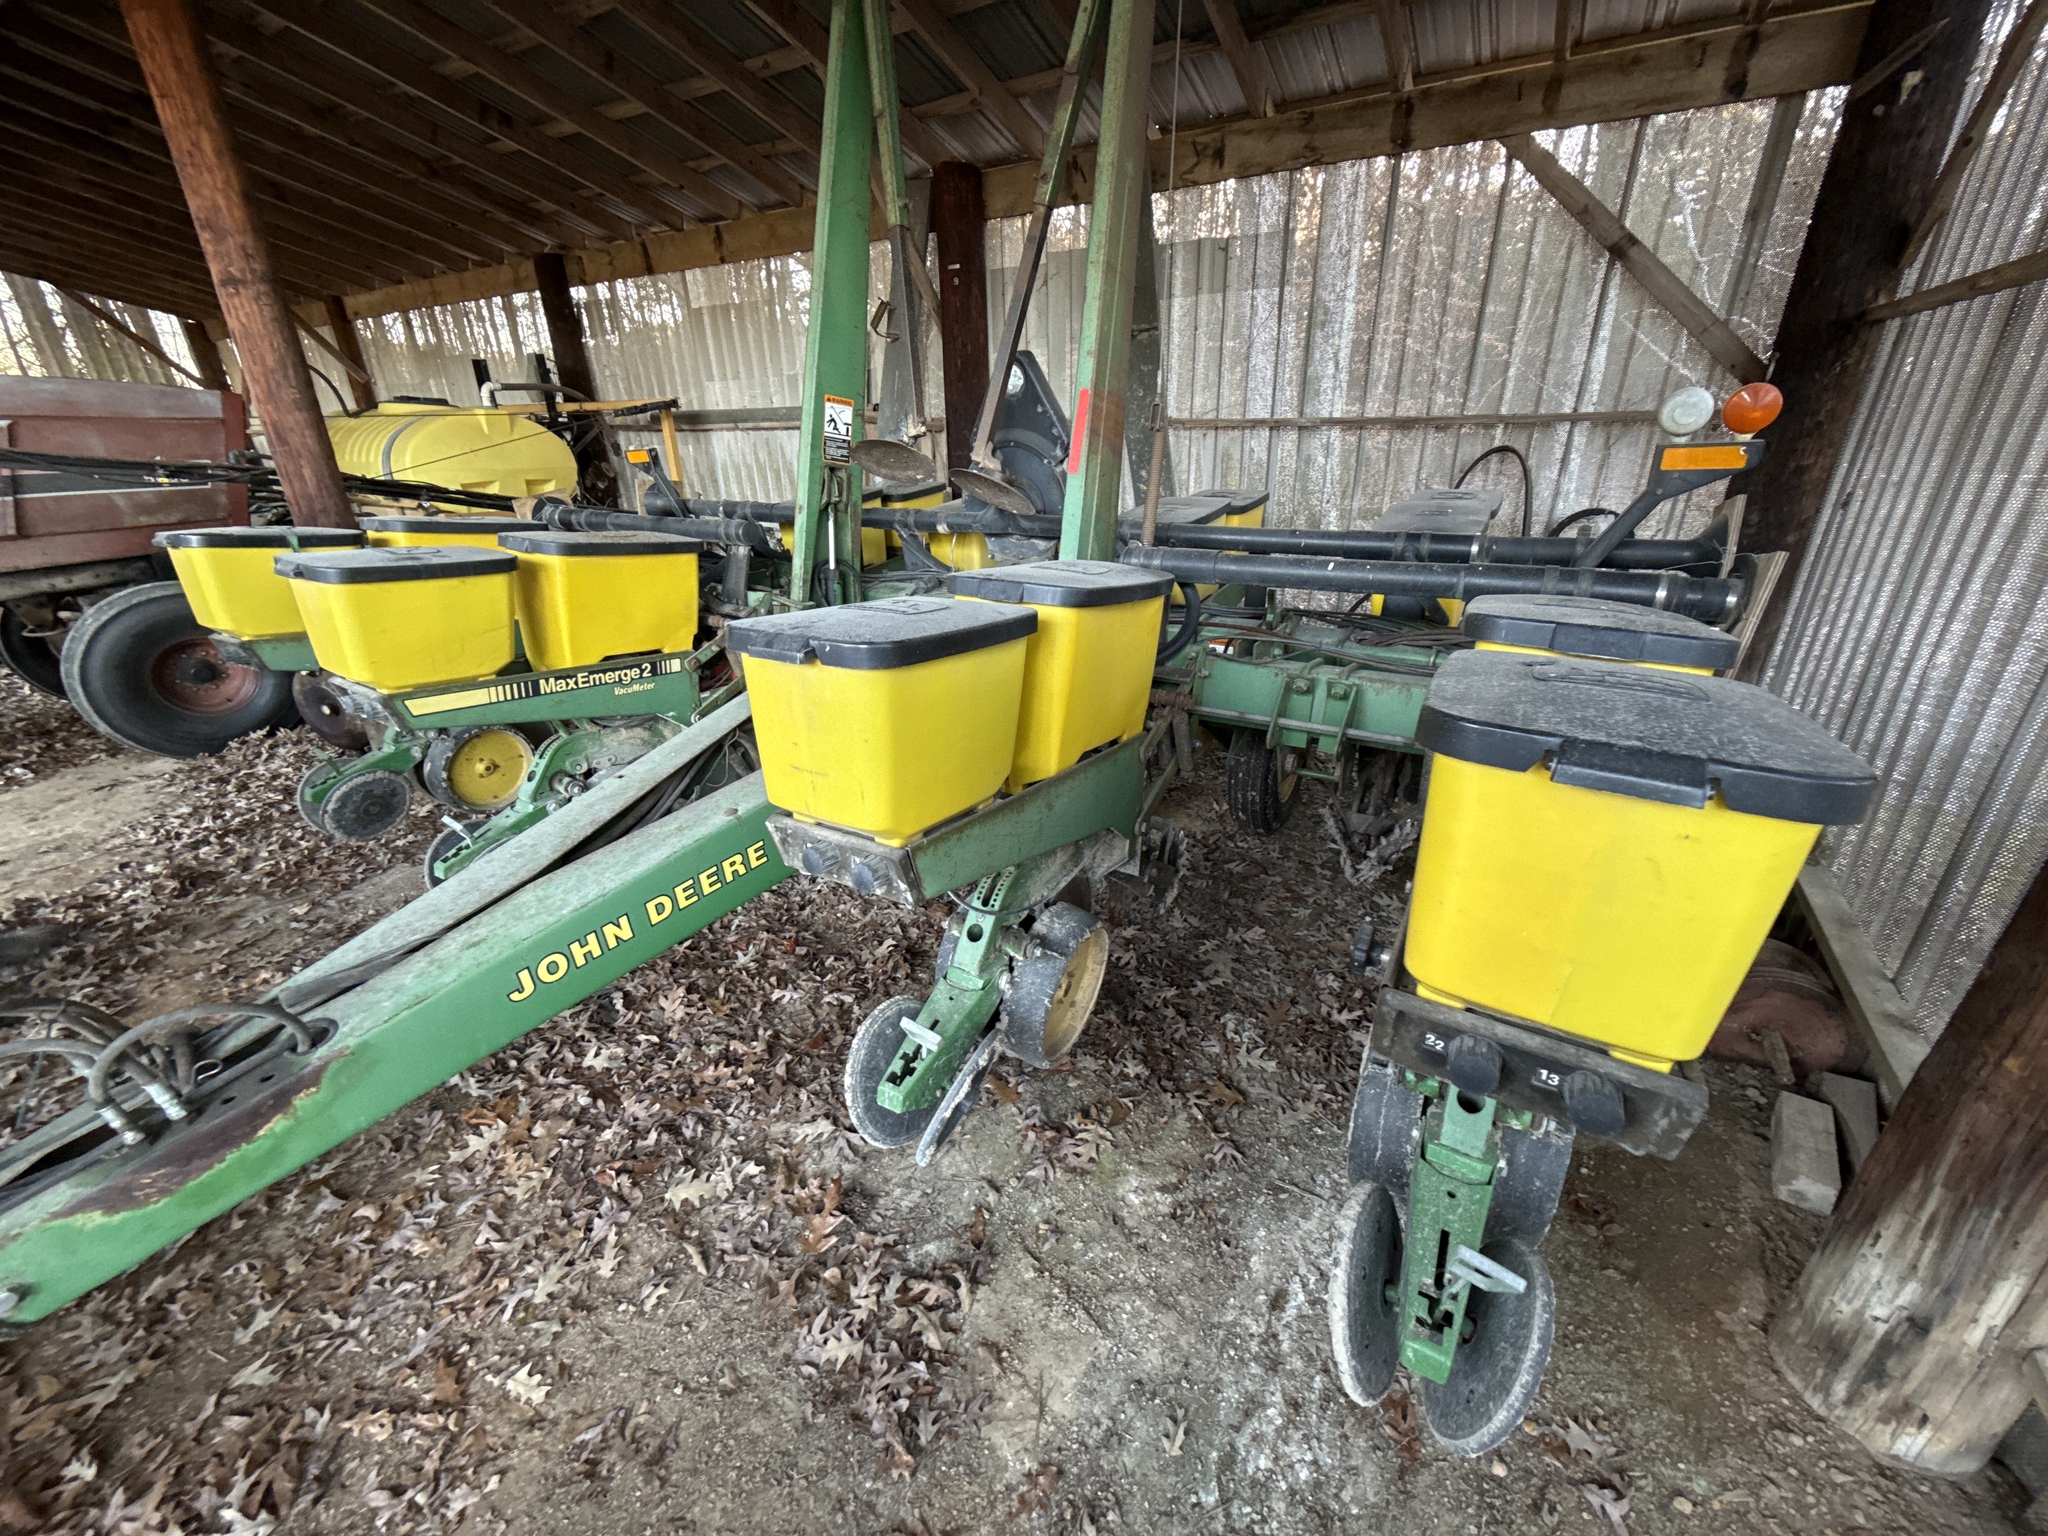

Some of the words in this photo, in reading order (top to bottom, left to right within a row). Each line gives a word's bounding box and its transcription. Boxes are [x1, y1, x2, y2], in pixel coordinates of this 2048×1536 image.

[831, 397, 853, 407] WARNING
[539, 666, 641, 695] MaxEmerge
[641, 662, 652, 678] 2
[614, 682, 656, 696] VacuMeter
[507, 913, 635, 1002] JOHN
[644, 839, 769, 926] DEERE
[1424, 1033, 1445, 1051] 22
[1539, 1068, 1560, 1087] 13
